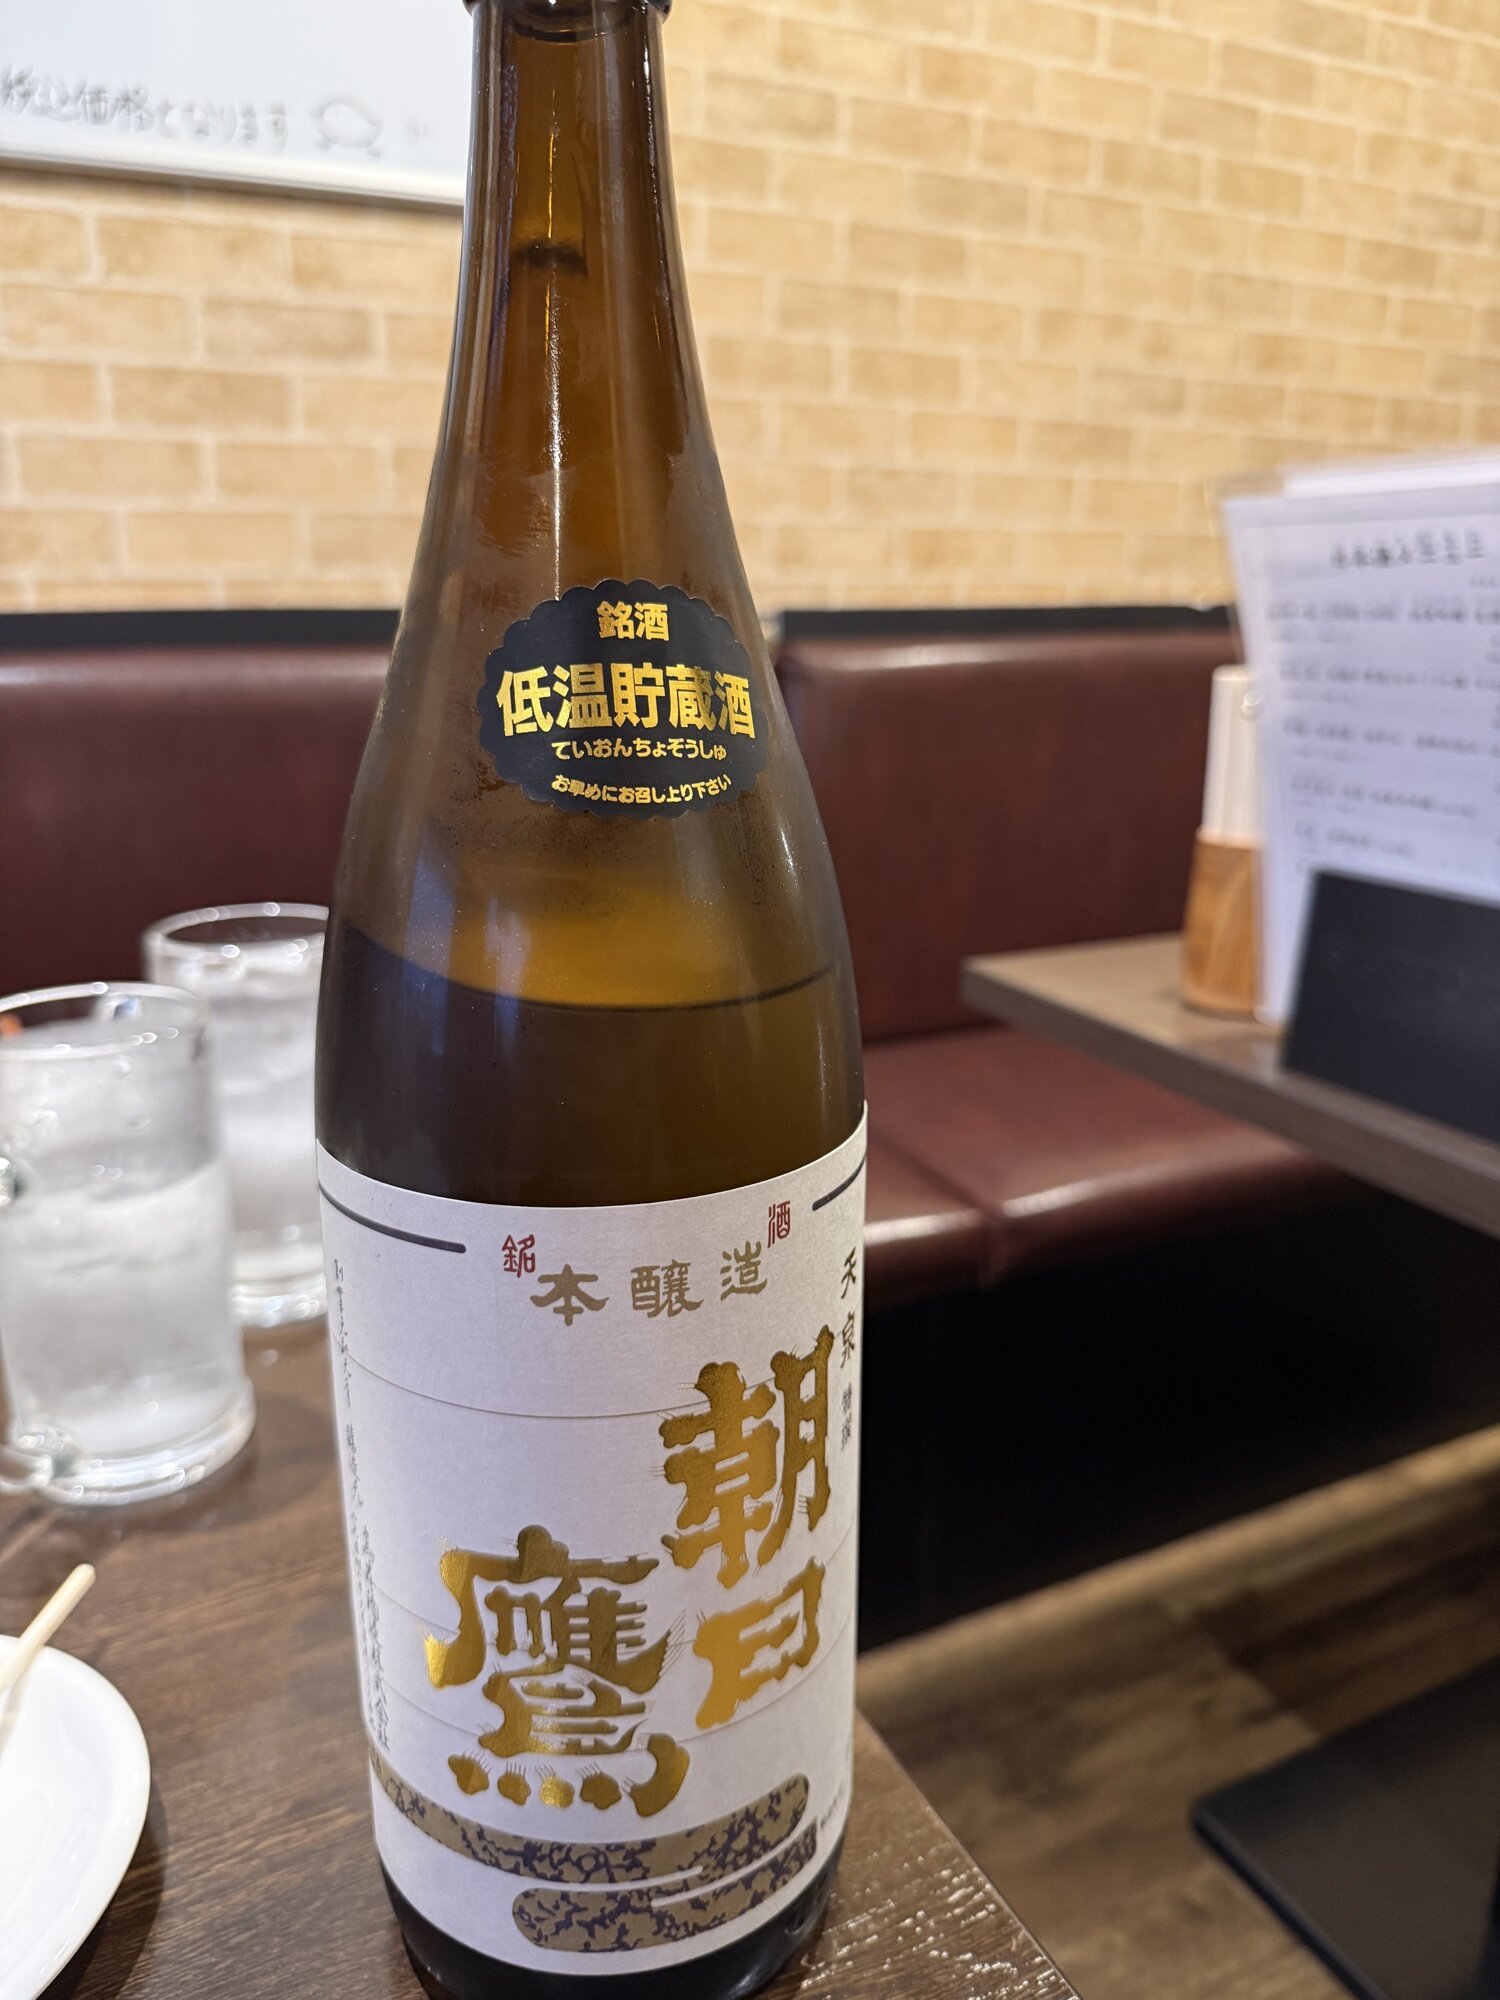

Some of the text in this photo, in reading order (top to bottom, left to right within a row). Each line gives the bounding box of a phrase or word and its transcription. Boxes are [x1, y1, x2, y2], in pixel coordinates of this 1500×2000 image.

[596, 601, 670, 642] 銘酒
[496, 662, 756, 739] 低温貯蔵酒
[551, 738, 727, 761] ていおんちょぞうしゅ
[551, 773, 732, 805] お早めにお召し上り下さい
